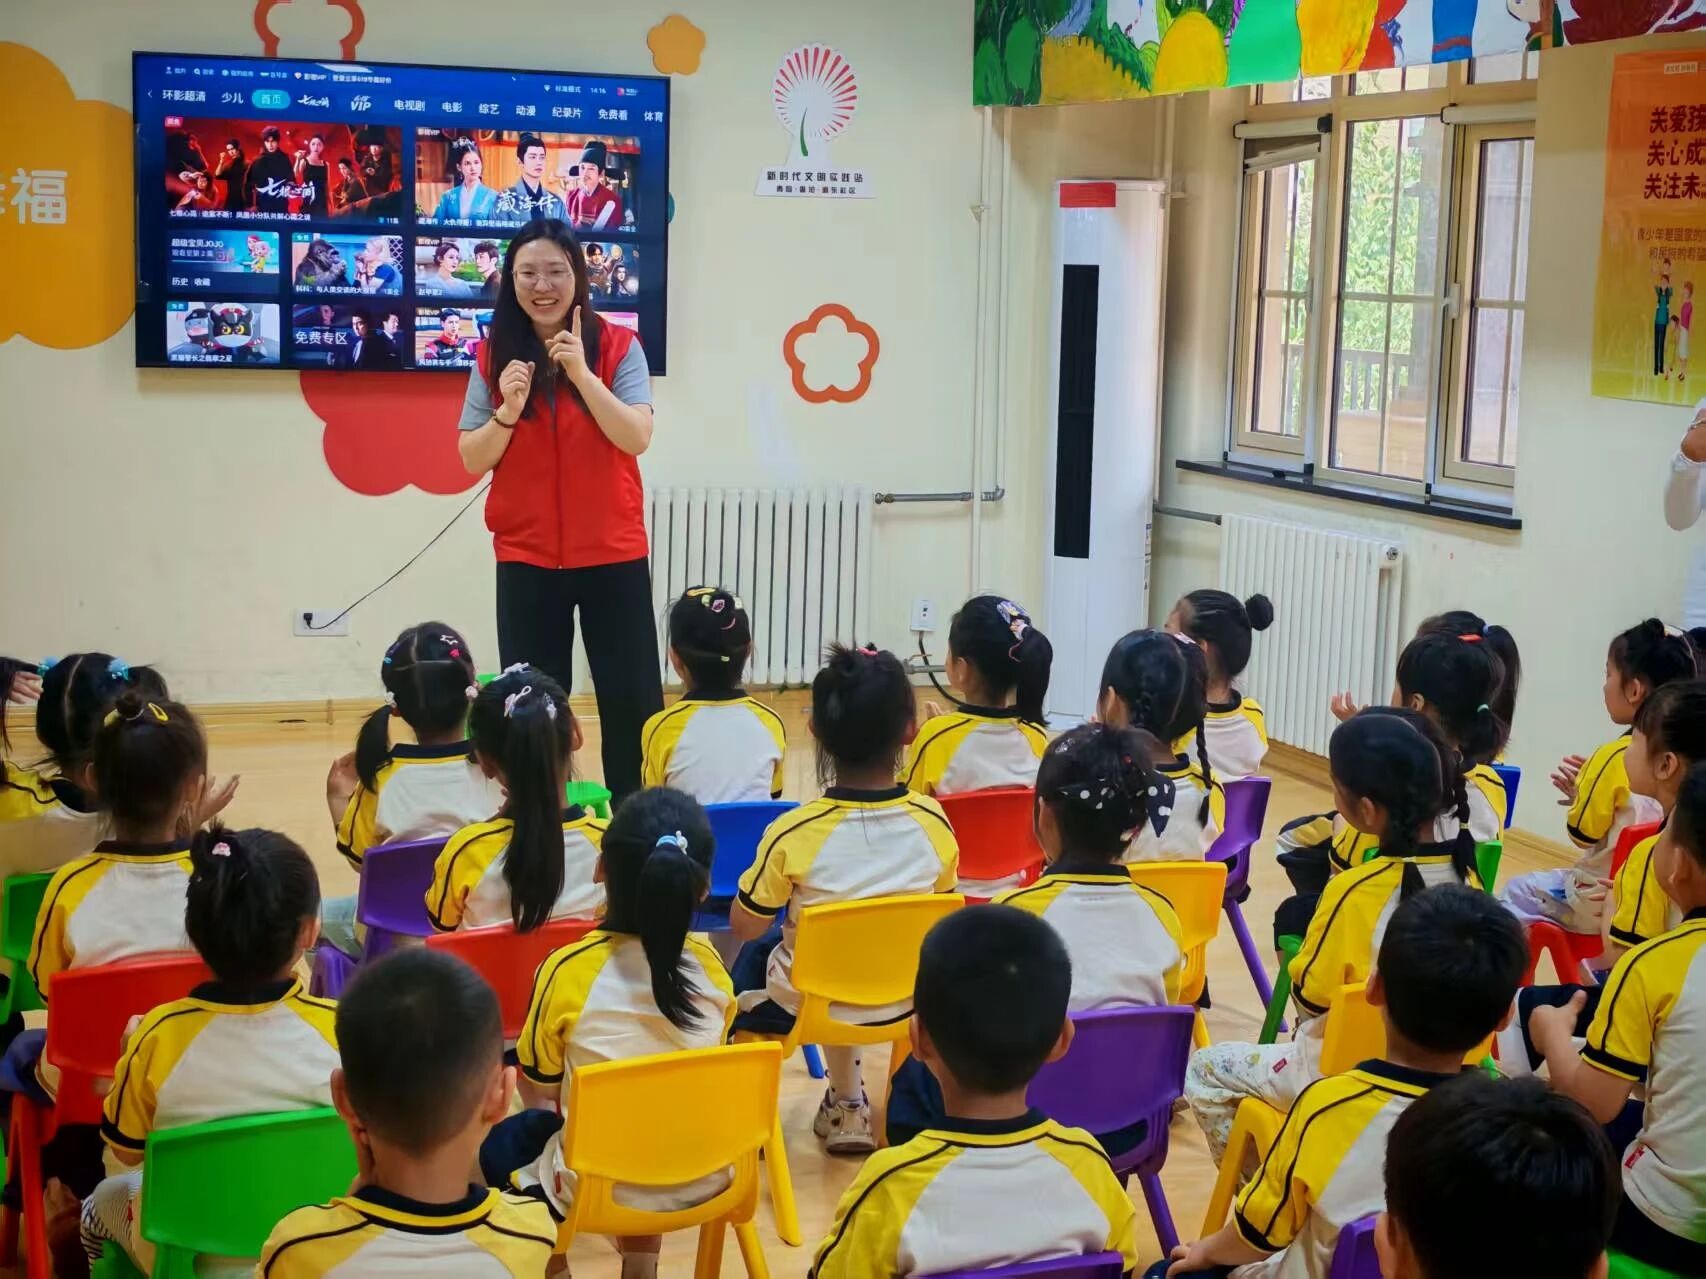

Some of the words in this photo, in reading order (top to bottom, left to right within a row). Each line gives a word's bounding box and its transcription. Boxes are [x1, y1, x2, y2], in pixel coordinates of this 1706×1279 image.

[162, 89, 206, 102] 环影超清
[221, 92, 244, 104] 少儿
[261, 94, 281, 105] 首页
[350, 101, 372, 111] VIP
[394, 99, 426, 112] 电视剧
[442, 101, 463, 113] 电影
[478, 103, 500, 115] 综艺
[515, 105, 536, 117] 动漫
[552, 106, 582, 119] 纪录片
[598, 108, 628, 121] 免费看
[644, 111, 664, 123] 体育
[767, 170, 863, 183] 新时代文明实践站
[1644, 171, 1706, 199] 关注未
[0, 167, 68, 225] 福
[496, 190, 559, 215] 藏海传
[295, 330, 348, 345] 免费专区
